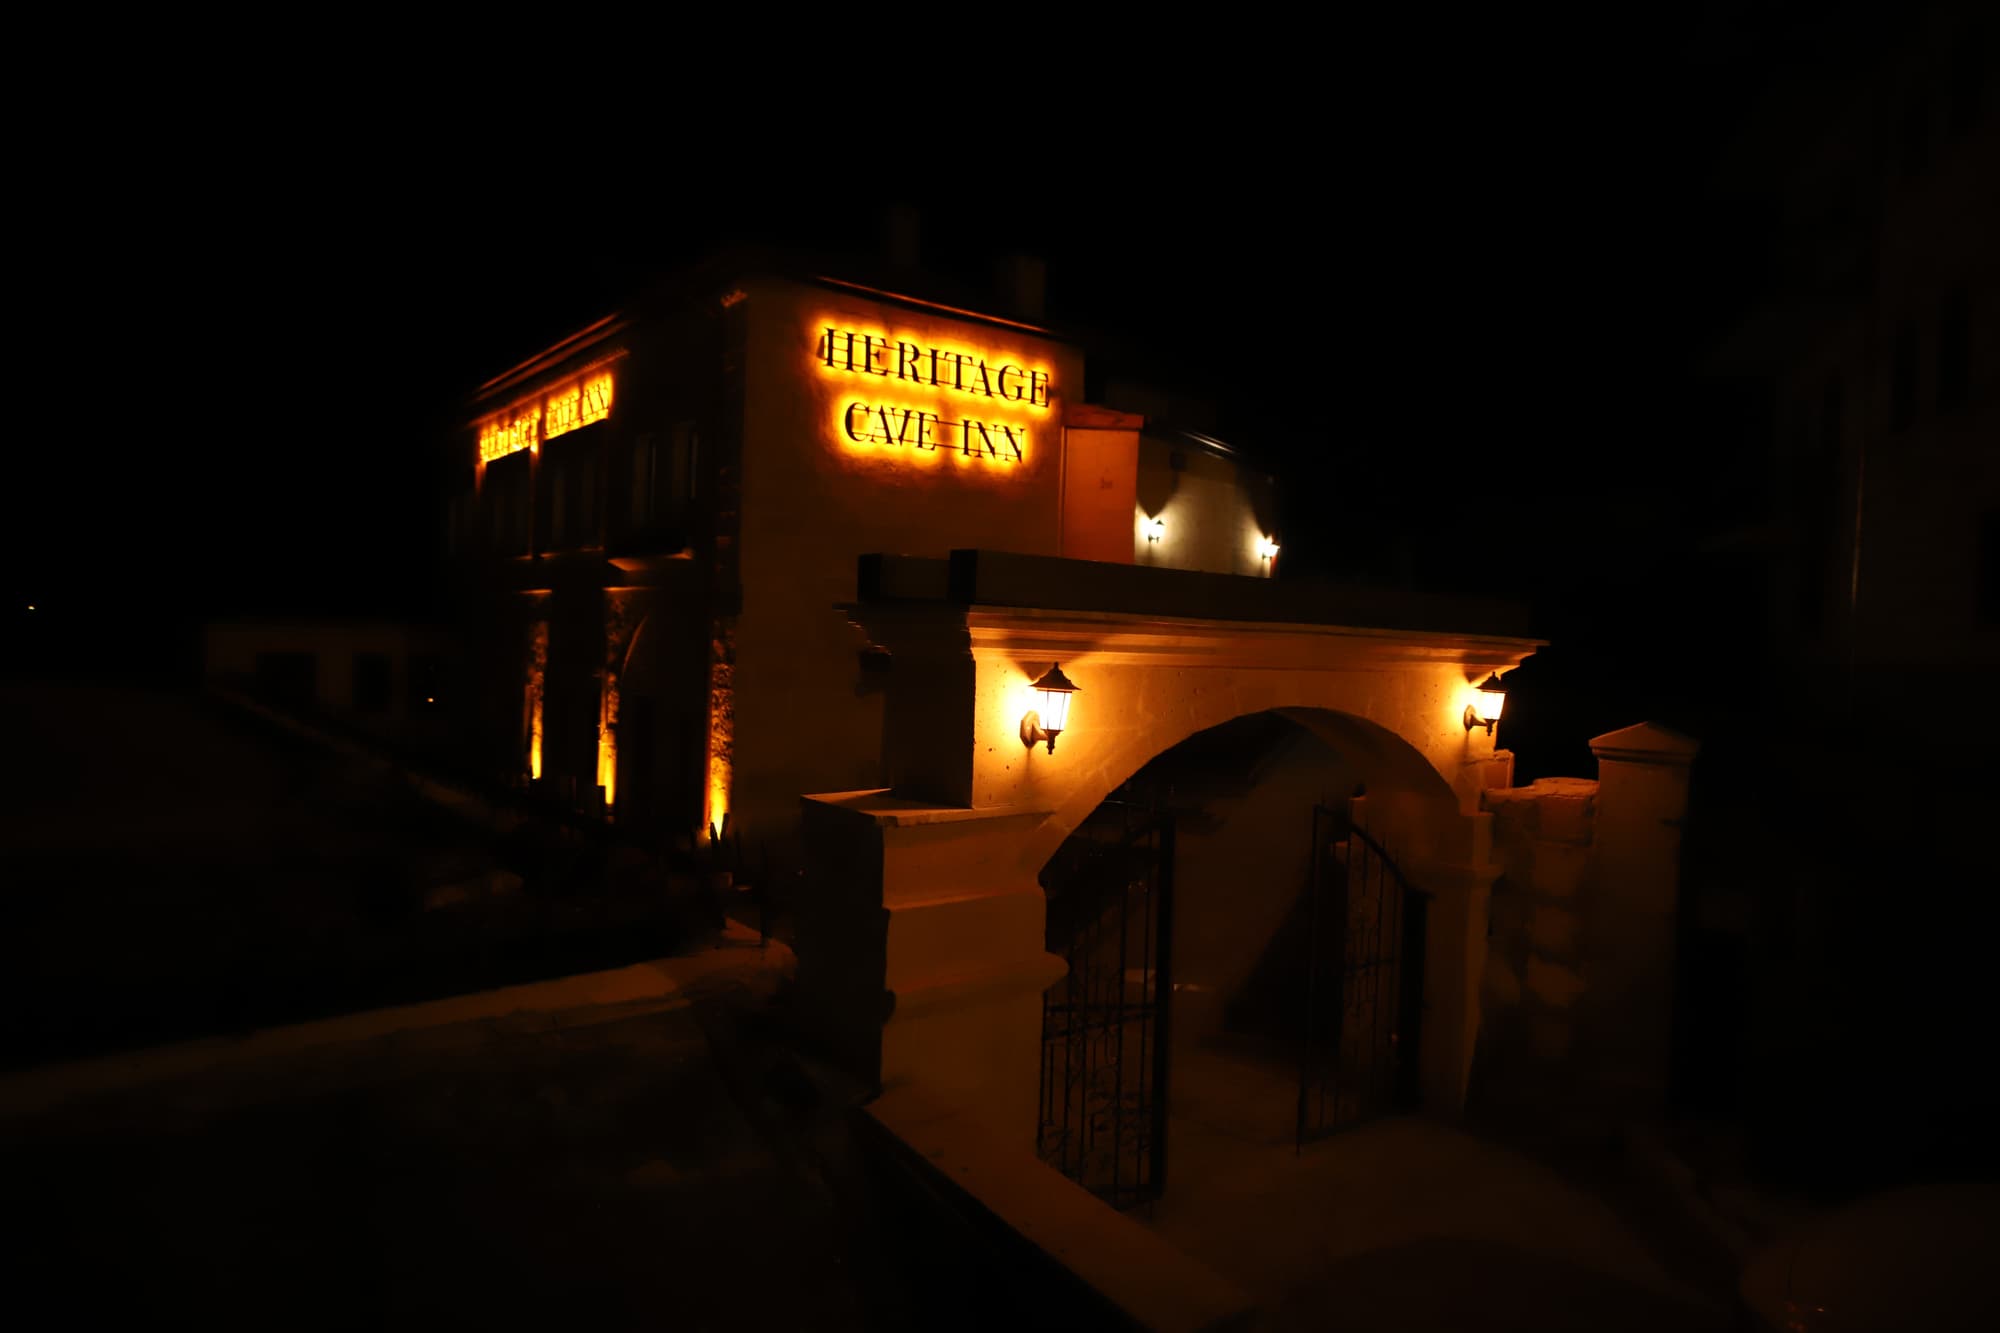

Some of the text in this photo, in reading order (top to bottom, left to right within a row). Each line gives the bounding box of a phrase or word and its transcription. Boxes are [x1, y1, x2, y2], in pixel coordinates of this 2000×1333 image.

[824, 328, 1050, 407] HERITAGE
[845, 402, 1025, 463] CAVE INN
